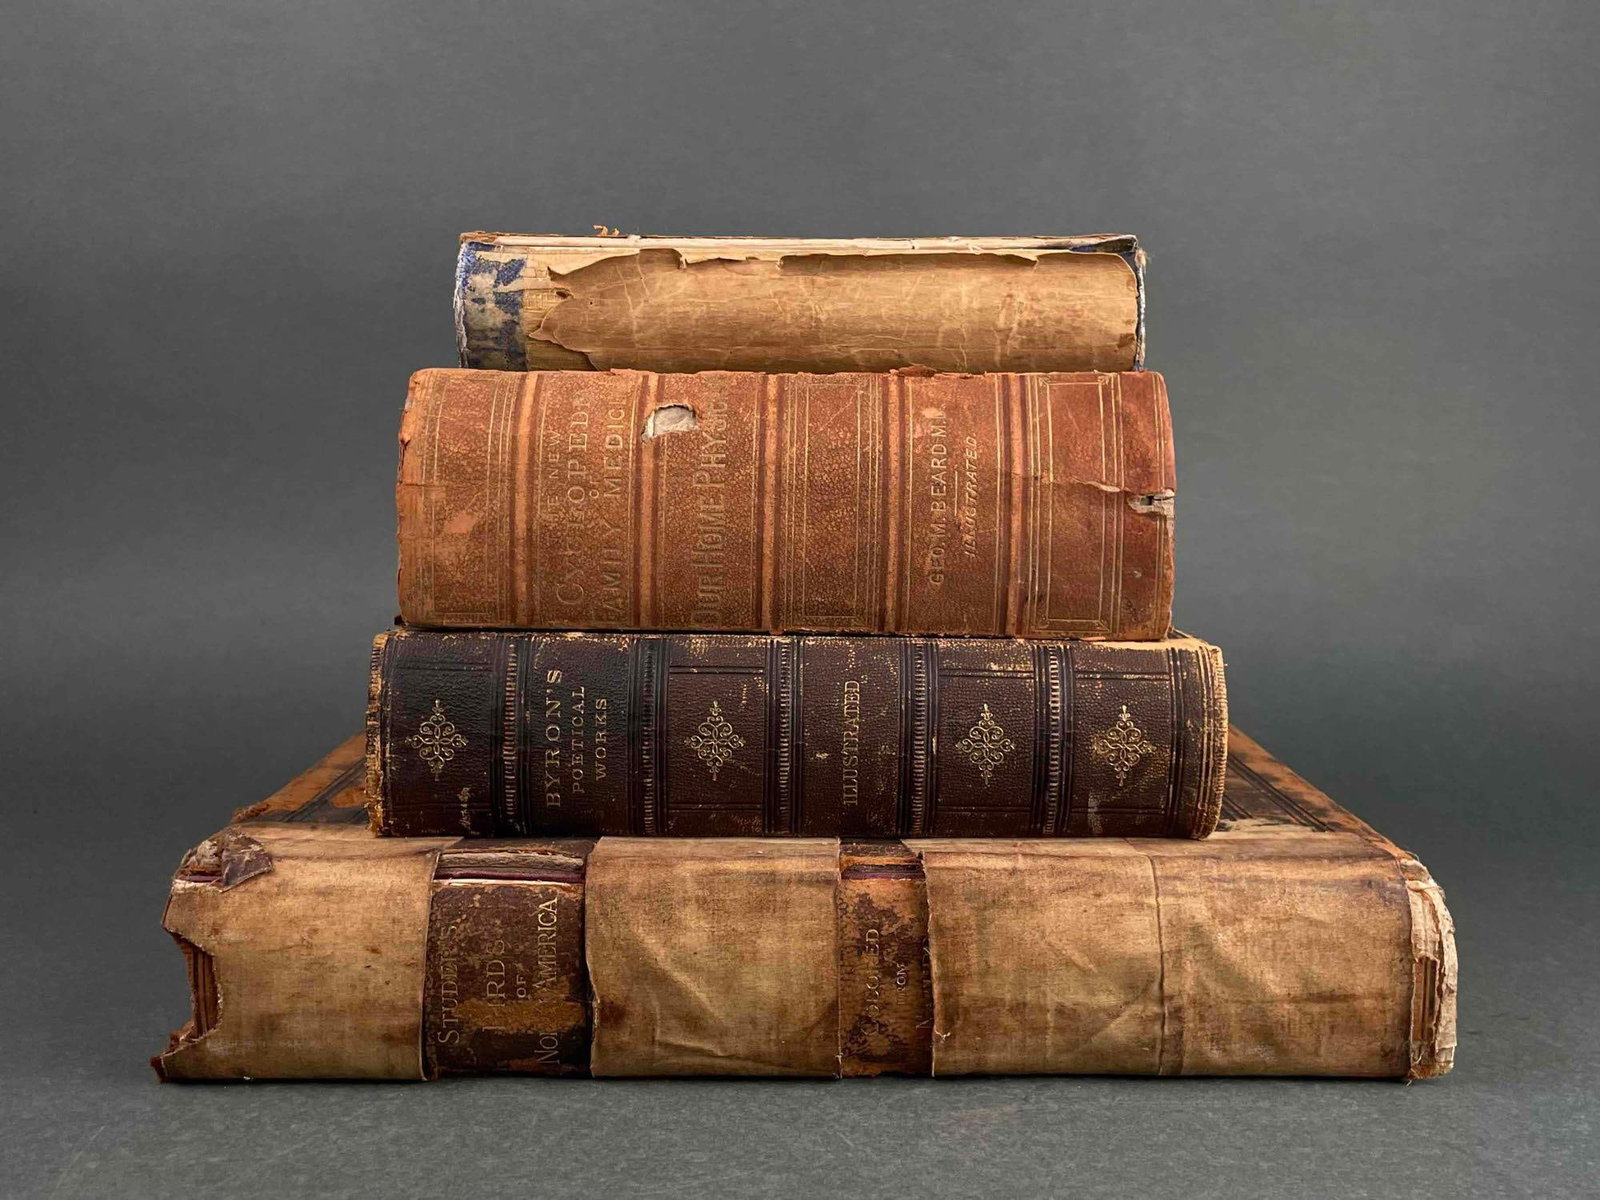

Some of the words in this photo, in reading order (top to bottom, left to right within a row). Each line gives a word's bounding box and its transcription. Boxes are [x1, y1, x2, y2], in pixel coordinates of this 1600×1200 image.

[547, 429, 561, 479] NEW
[930, 443, 947, 513] BEARD
[691, 494, 725, 568] HOME
[929, 517, 947, 538] M.
[690, 574, 723, 630] OUR
[544, 668, 563, 808] BYRON'S
[571, 685, 586, 794] POETICAL
[595, 697, 607, 781] WORKS
[842, 679, 860, 806] ILLUSTRATED
[532, 897, 559, 990] AMERICA
[516, 974, 527, 999] OF
